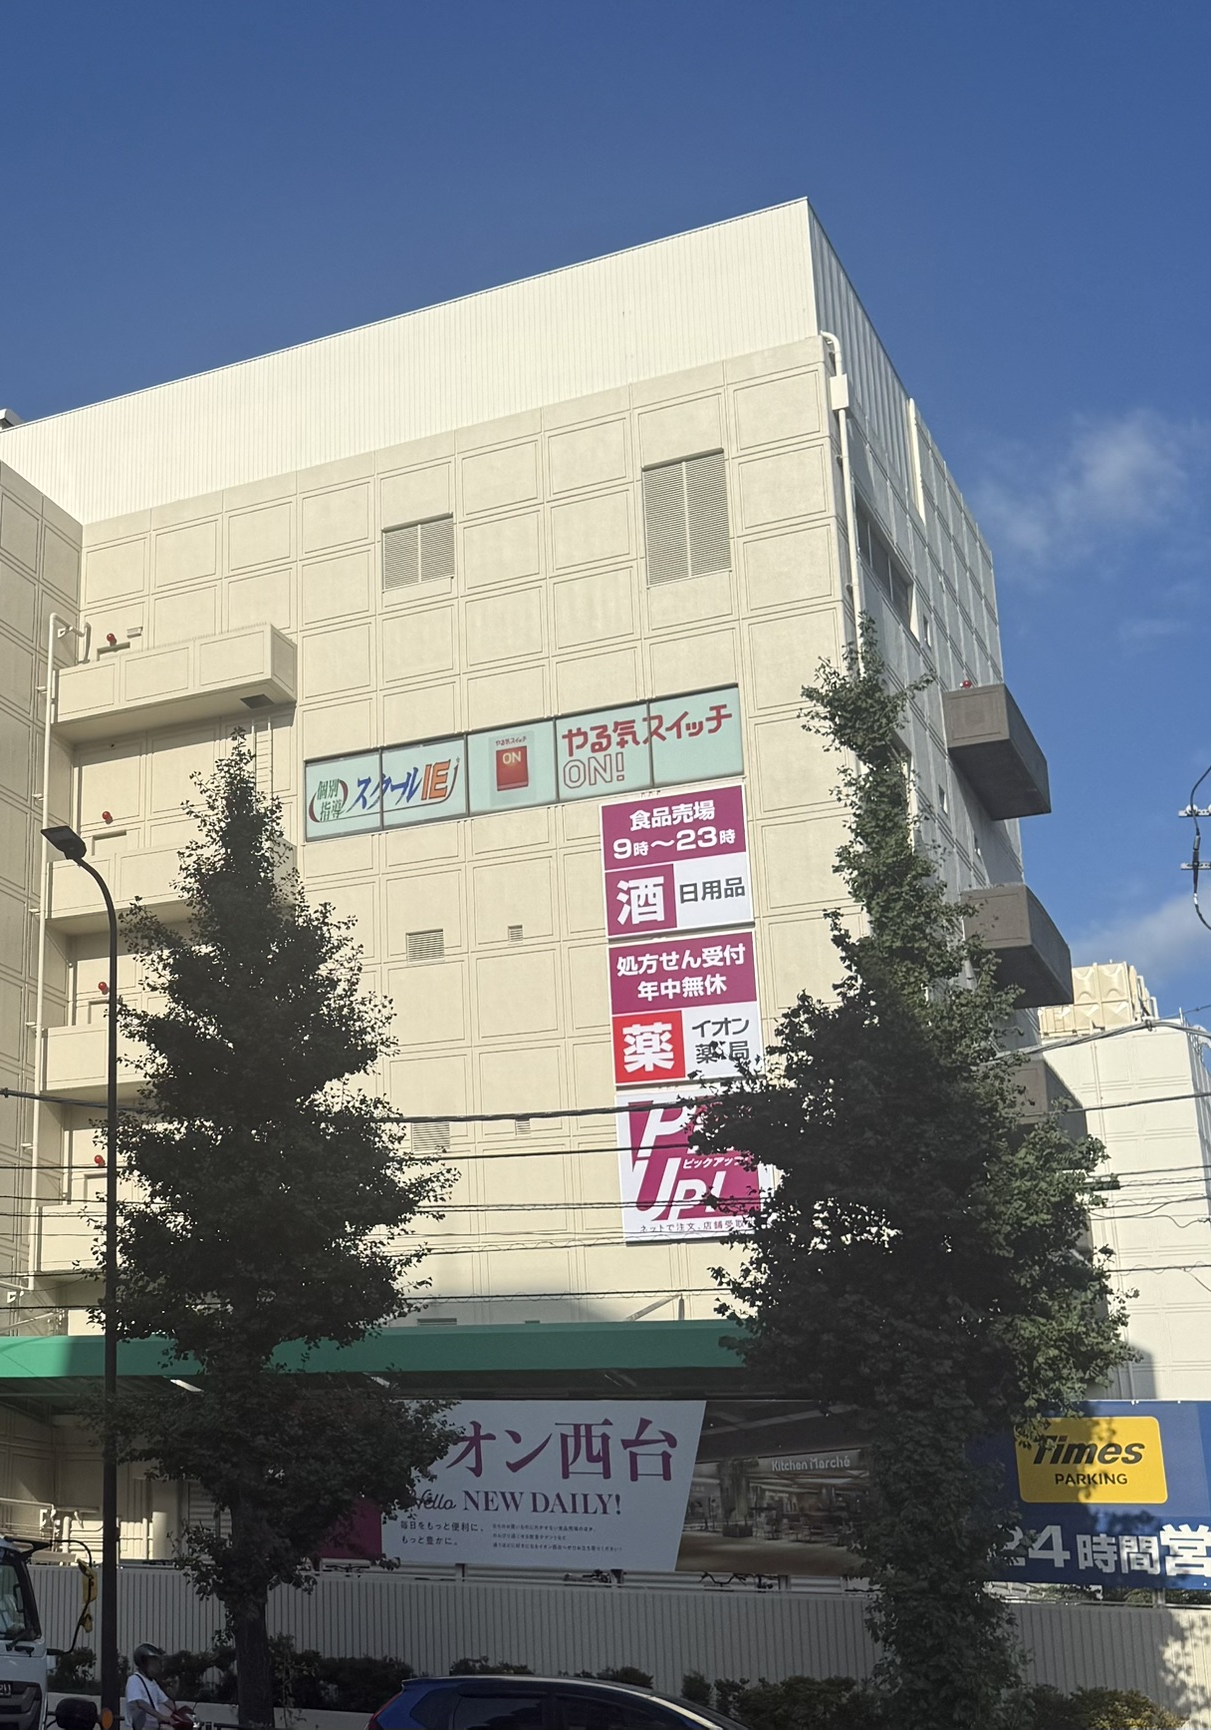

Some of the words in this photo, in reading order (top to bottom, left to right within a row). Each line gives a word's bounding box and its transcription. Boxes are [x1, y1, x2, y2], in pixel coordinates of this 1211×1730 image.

[561, 703, 734, 758] やる気スイッチ
[502, 750, 522, 765] ON
[562, 751, 626, 790] ON!
[629, 799, 716, 831] 食品売場
[616, 875, 666, 926] 酒
[679, 876, 746, 904] 日用品
[616, 943, 747, 976] 処方せん受付
[637, 972, 728, 1002] 年中無休
[691, 1016, 750, 1038] イオン
[623, 1022, 675, 1074] 薬
[695, 1040, 750, 1064] 薬局
[639, 1219, 753, 1233] ネットで注文、店舗受取
[1033, 1434, 1146, 1465] Times
[771, 1458, 808, 1472] Kitchen
[1055, 1473, 1128, 1485] PARKING
[463, 1490, 525, 1513] NEW
[531, 1491, 622, 1516] DAILY!
